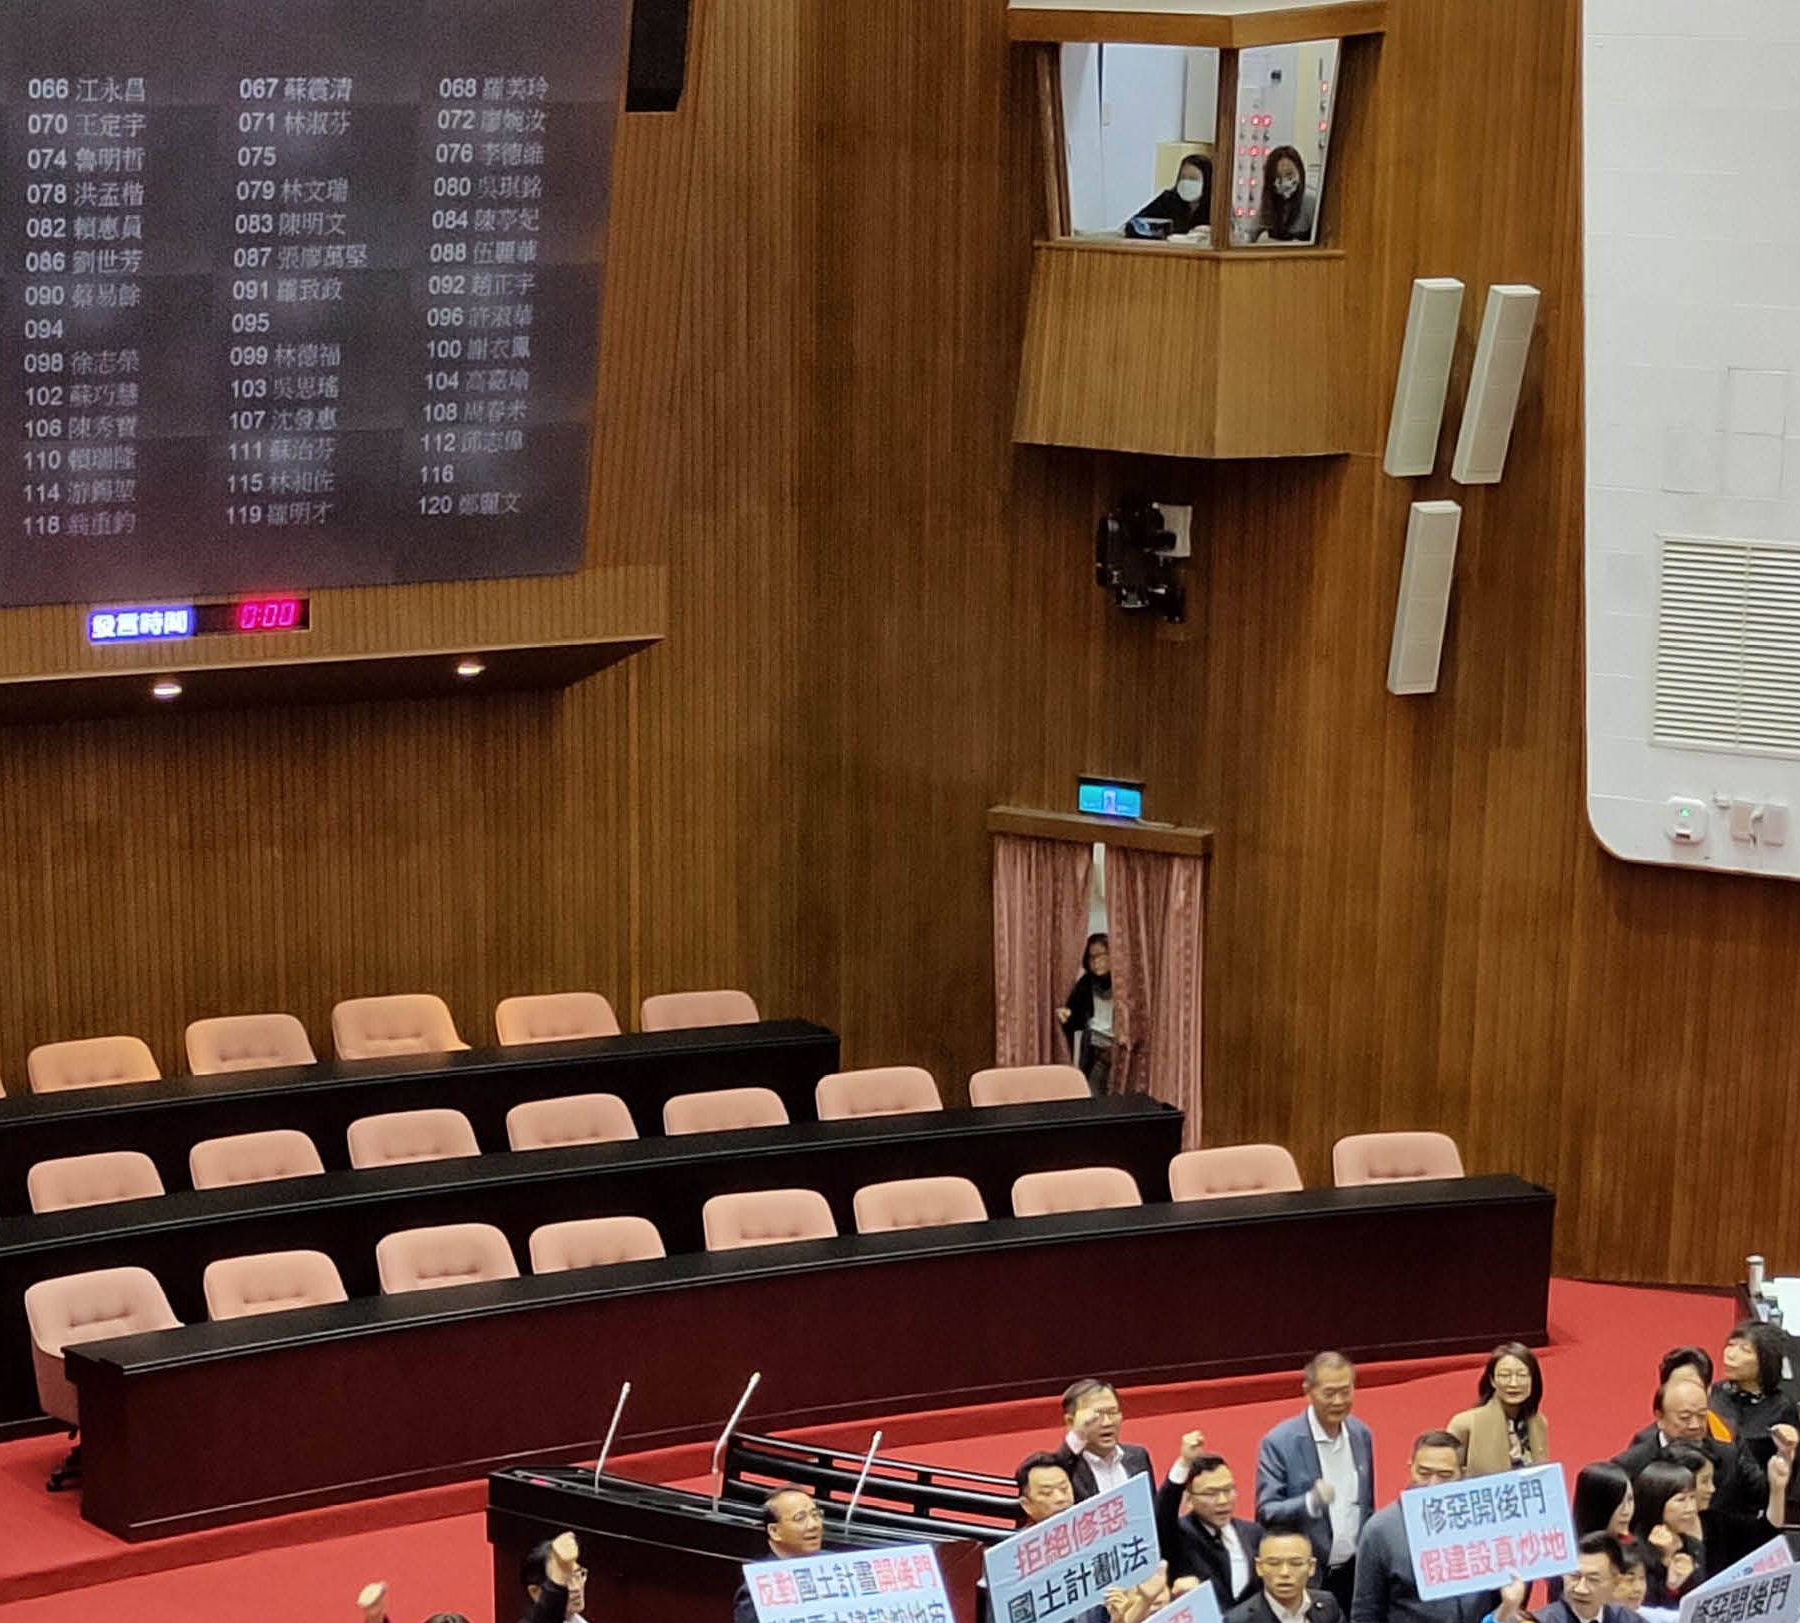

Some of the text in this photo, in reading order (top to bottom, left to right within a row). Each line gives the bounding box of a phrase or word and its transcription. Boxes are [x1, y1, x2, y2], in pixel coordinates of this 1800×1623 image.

[29, 77, 145, 102] 066 江永昌
[240, 78, 278, 98] 067
[439, 78, 476, 97] 068
[28, 114, 68, 134] 070
[239, 112, 274, 132] 071
[438, 109, 475, 129] 072
[27, 149, 67, 169] 074
[238, 146, 276, 166] 075
[436, 143, 472, 163] 076
[27, 184, 66, 204] 078
[236, 180, 275, 200] 079
[434, 177, 471, 196] 080
[26, 218, 66, 238] 082
[235, 212, 346, 235] 083 陳明文
[432, 210, 468, 229] 084
[26, 251, 65, 272] 086
[234, 247, 272, 267] 087
[430, 243, 466, 262] 088
[233, 280, 268, 300] 091
[429, 275, 465, 294] 092
[25, 286, 64, 305] 090
[232, 313, 269, 332] 095
[427, 307, 463, 326] 096
[25, 319, 63, 339] 094
[230, 346, 268, 365] 099
[427, 340, 461, 358] 100
[24, 353, 63, 373] 098
[232, 379, 266, 398] 103
[425, 372, 459, 390] 104
[26, 386, 62, 405] 102
[230, 411, 265, 430] 107
[424, 403, 457, 421] 108
[25, 419, 61, 437] 106
[229, 442, 261, 460] 111
[422, 433, 455, 451] 112
[24, 450, 61, 469] 110
[228, 473, 262, 492] 115
[421, 465, 454, 483] 116
[24, 484, 60, 501] 114
[227, 506, 261, 523] 119
[420, 496, 452, 514] 120
[24, 516, 59, 534] 118
[240, 602, 296, 629] 0:00
[1421, 1478, 1546, 1537] 修惡開後門
[1015, 1496, 1126, 1581] 拒絕修惡
[1419, 1531, 1568, 1588] 假建設真炒地
[755, 1556, 935, 1607] 反對國土計畫開後門
